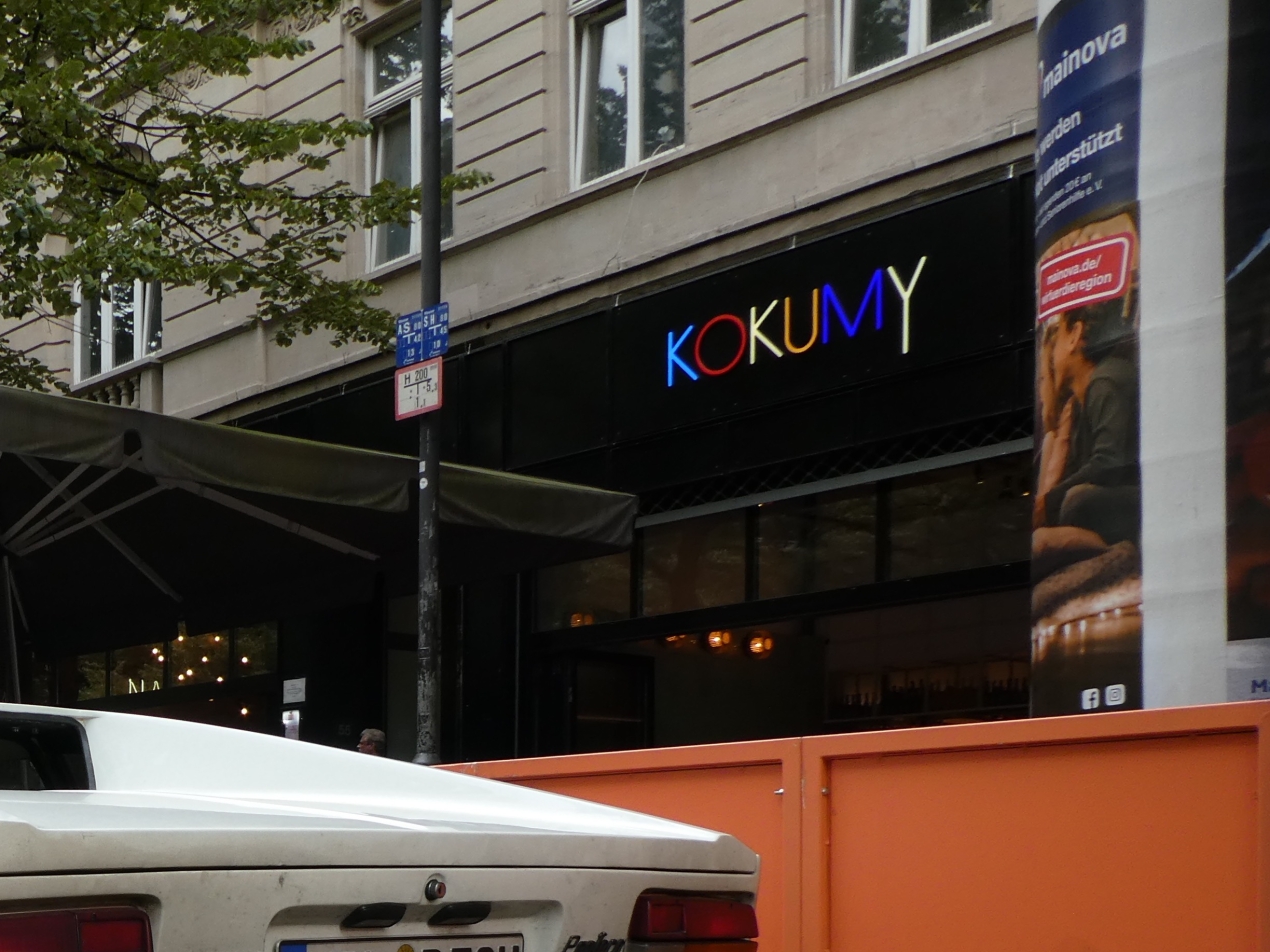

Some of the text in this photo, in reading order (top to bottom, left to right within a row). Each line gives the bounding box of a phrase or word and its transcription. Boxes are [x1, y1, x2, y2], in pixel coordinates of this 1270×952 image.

[1042, 23, 1127, 98] mainova
[1038, 110, 1081, 155] werden
[1043, 122, 1123, 187] unterstützt
[667, 255, 927, 387] KOKUMY
[404, 373, 411, 386] H
[414, 367, 429, 382] 200
[1251, 679, 1270, 694] M
